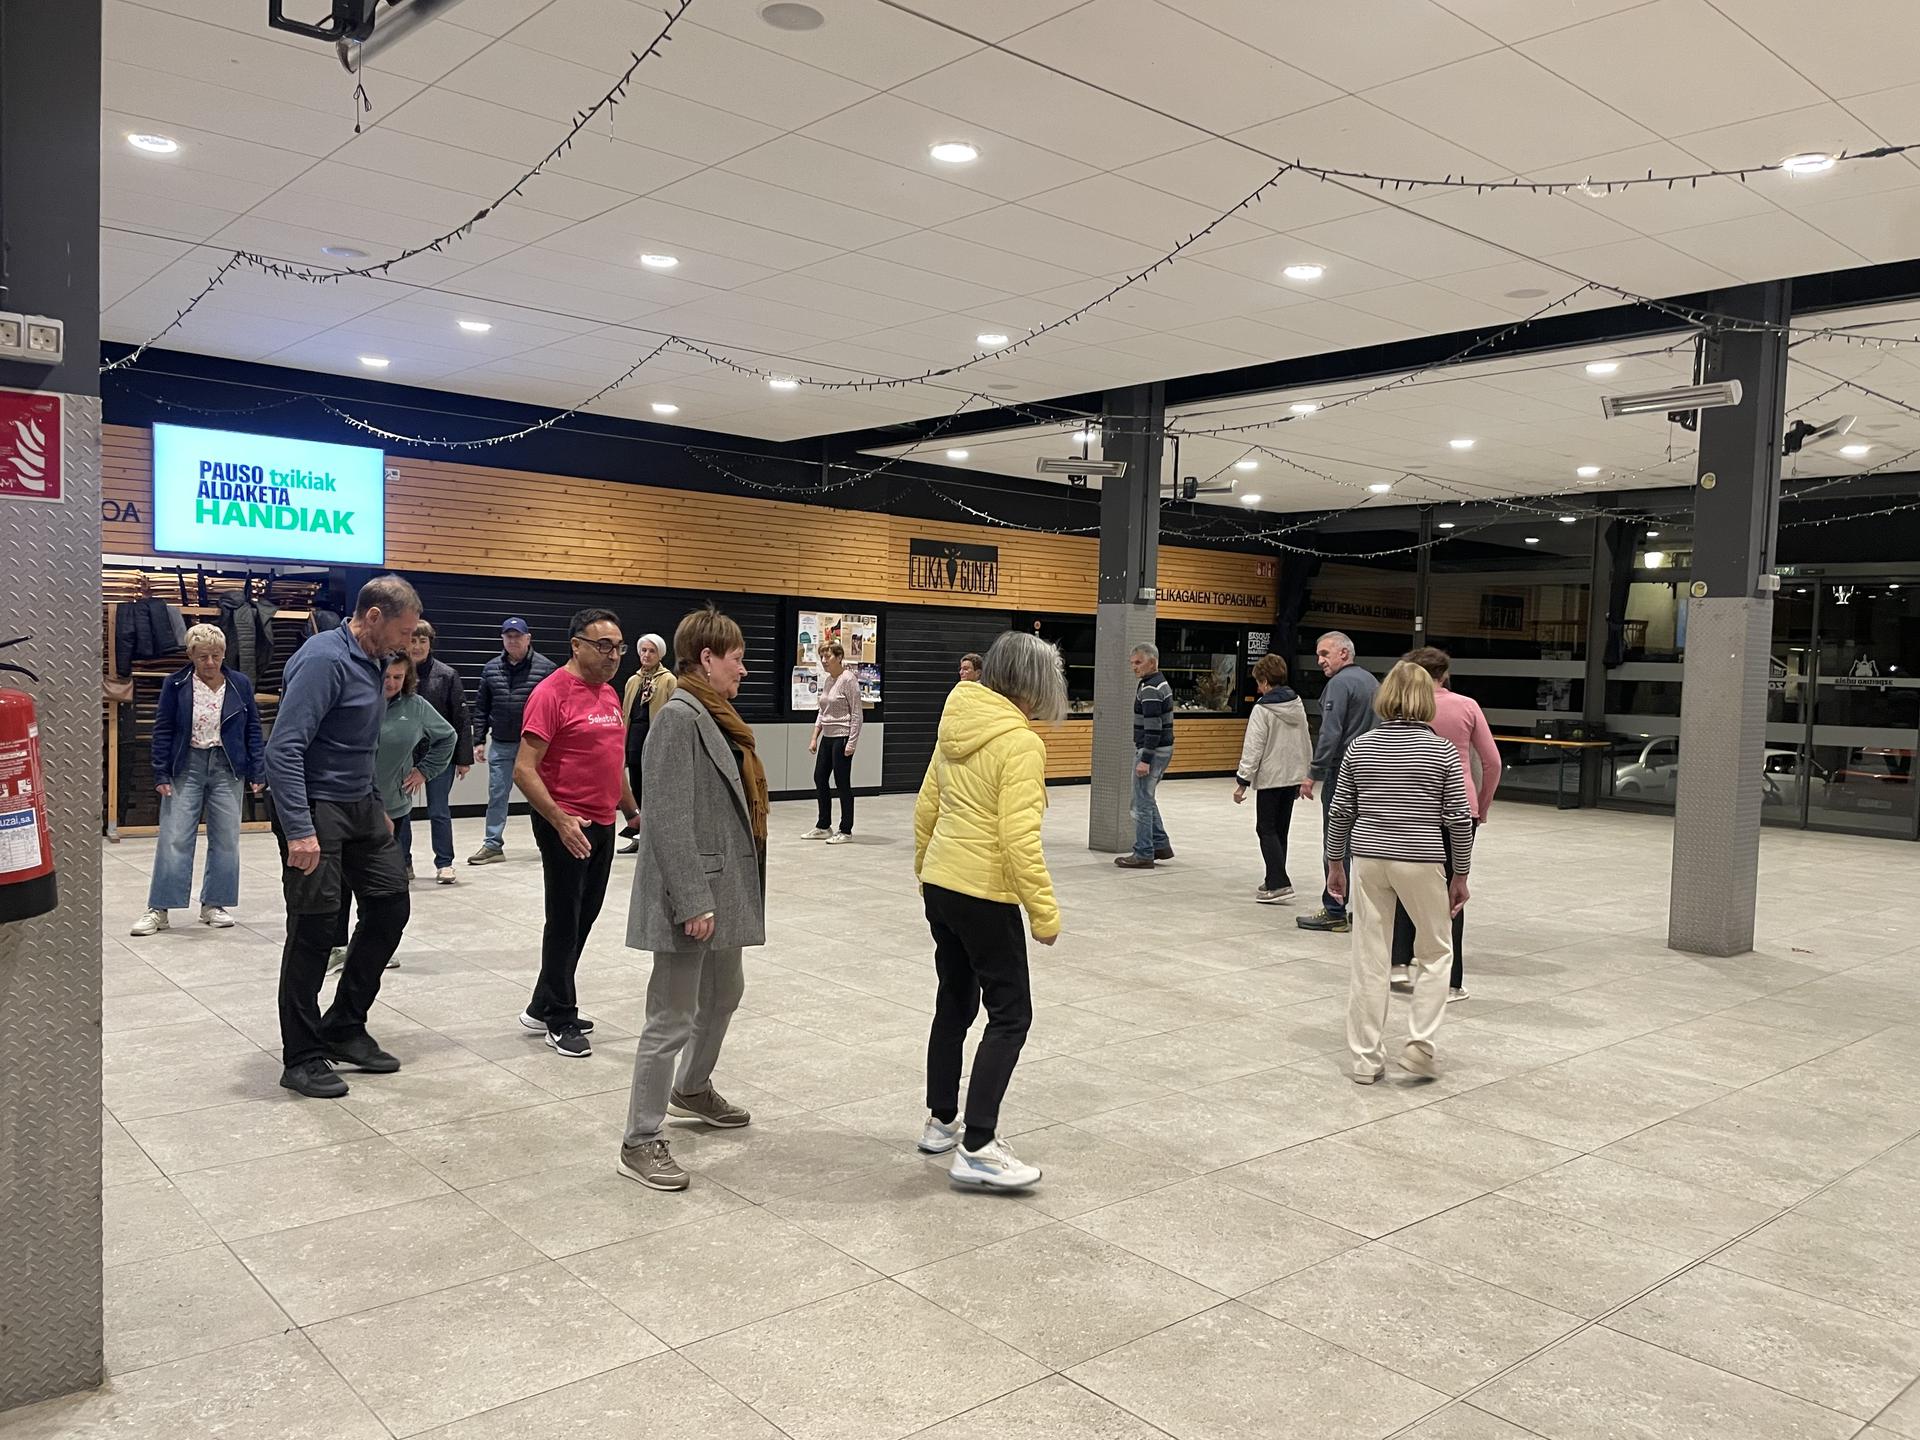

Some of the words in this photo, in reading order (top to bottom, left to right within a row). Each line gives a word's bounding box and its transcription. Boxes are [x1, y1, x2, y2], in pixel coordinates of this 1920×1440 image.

[199, 460, 264, 485] PAUSO
[269, 468, 337, 492] txikiak
[197, 480, 291, 506] ALDAKETA
[195, 499, 355, 536] HANDIAK
[911, 555, 943, 589] ELIKA
[960, 560, 995, 593] GUNEA
[1156, 588, 1210, 604] ELIKAGAIEN
[1213, 591, 1267, 608] TOPAGUNEA
